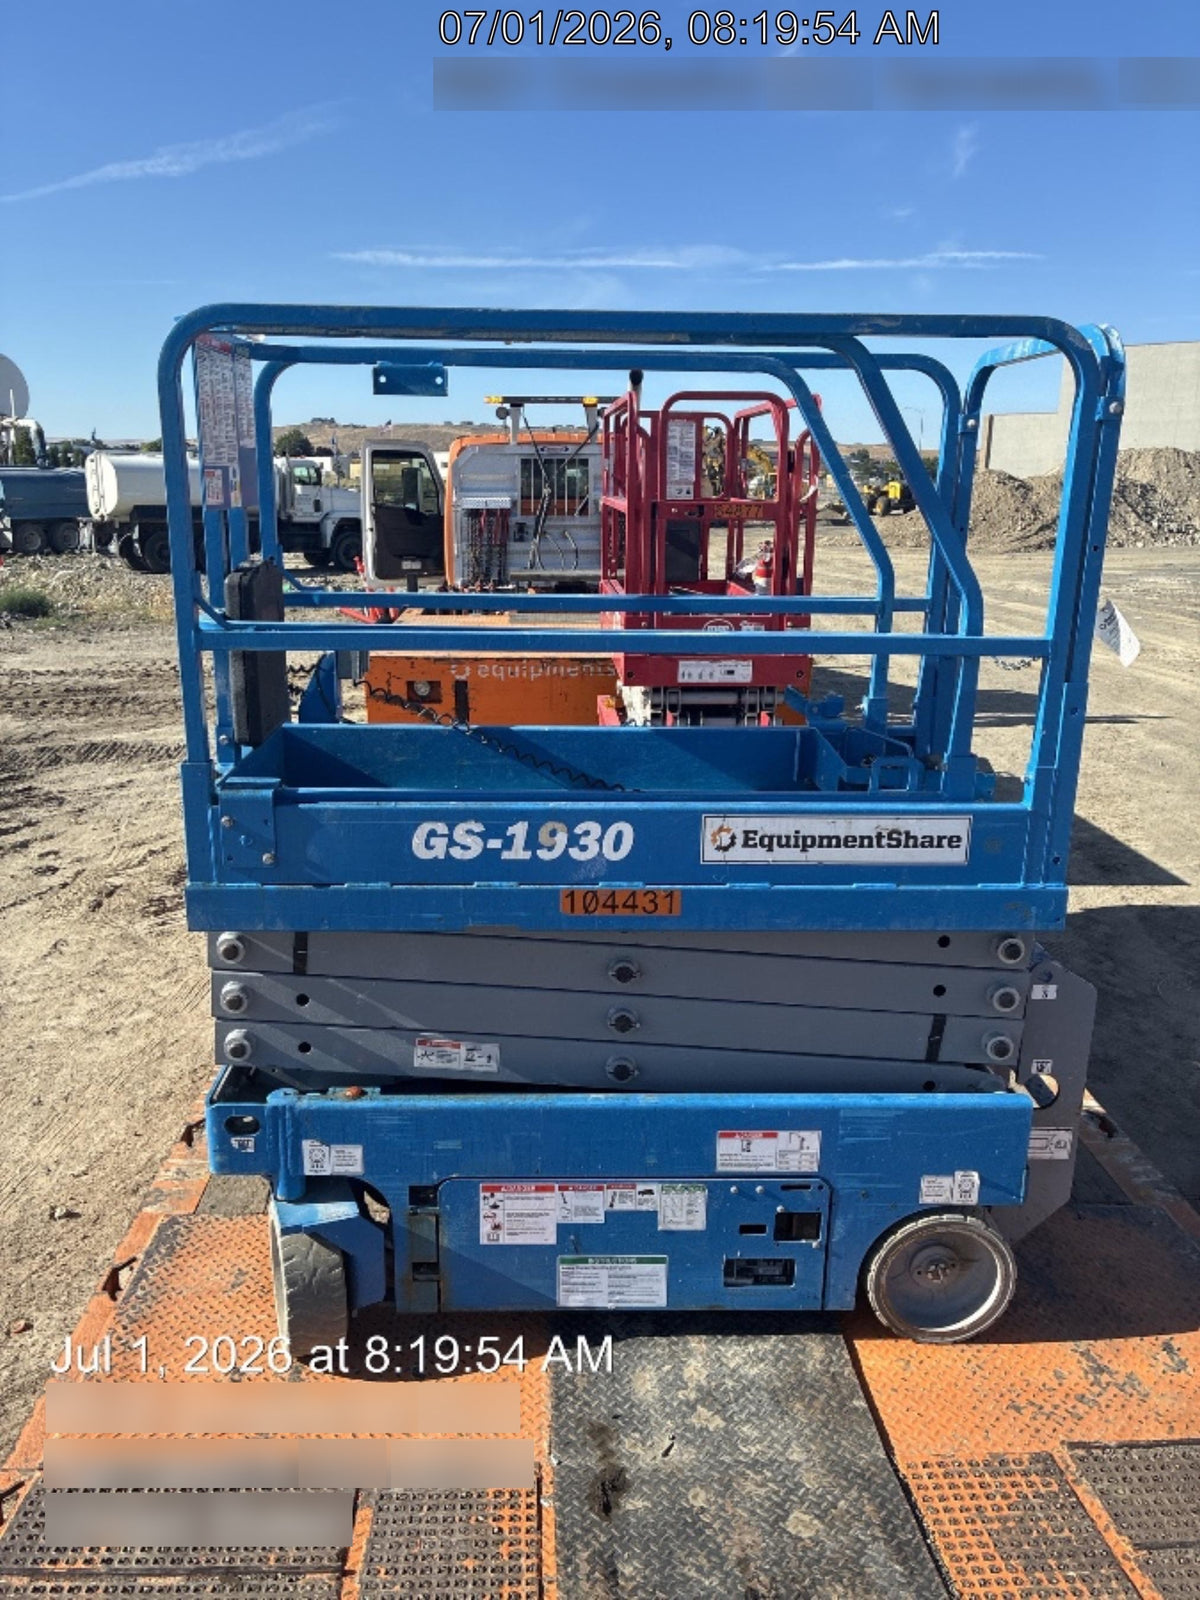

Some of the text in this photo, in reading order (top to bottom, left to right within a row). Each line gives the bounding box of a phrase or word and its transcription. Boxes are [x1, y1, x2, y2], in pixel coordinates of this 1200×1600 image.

[412, 821, 634, 861] GS-1930
[741, 829, 962, 852] EquipmentShare
[564, 889, 675, 915] 104431
